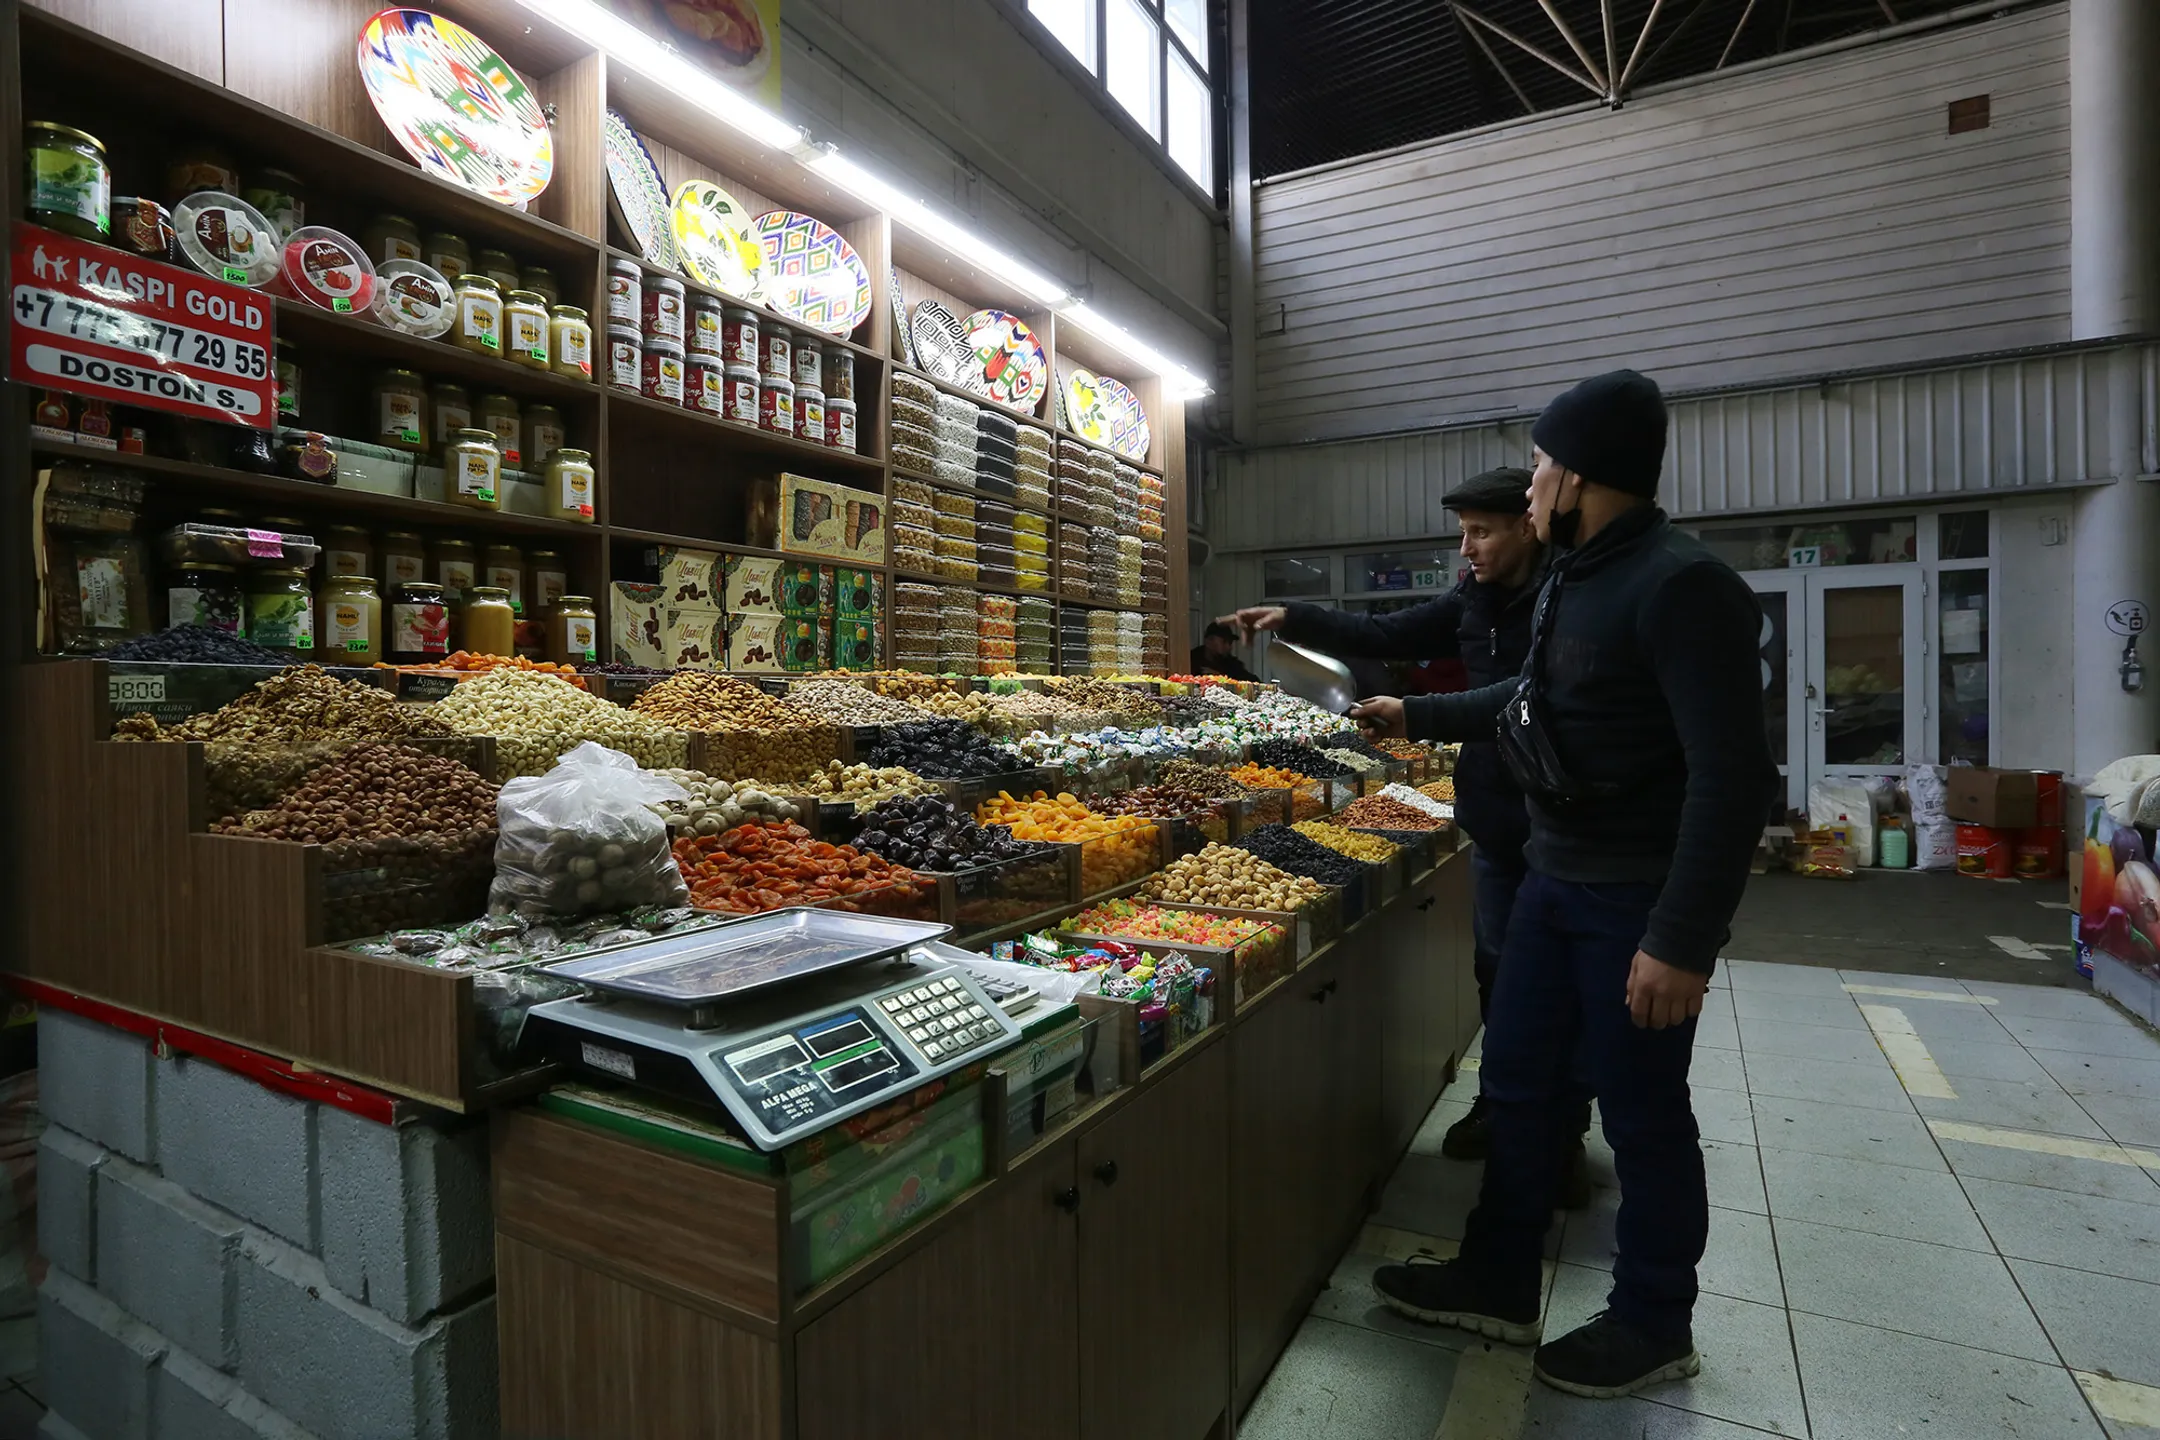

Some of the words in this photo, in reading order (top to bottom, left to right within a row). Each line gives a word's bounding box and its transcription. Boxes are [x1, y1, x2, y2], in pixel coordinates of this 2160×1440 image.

[226, 273, 245, 282] 1500
[78, 257, 175, 308] KASPI
[185, 289, 263, 331] GOLD
[16, 292, 55, 327] +7
[194, 334, 226, 368] 29
[235, 345, 266, 378] 55
[60, 354, 205, 402] DOSTON
[216, 389, 245, 411] S.
[1793, 550, 1816, 564] 17
[1416, 573, 1433, 586] 18
[417, 676, 446, 687] Курага
[115, 702, 151, 712] Изюм
[761, 1093, 789, 1109] ALFA
[786, 1081, 818, 1098] MEGA
